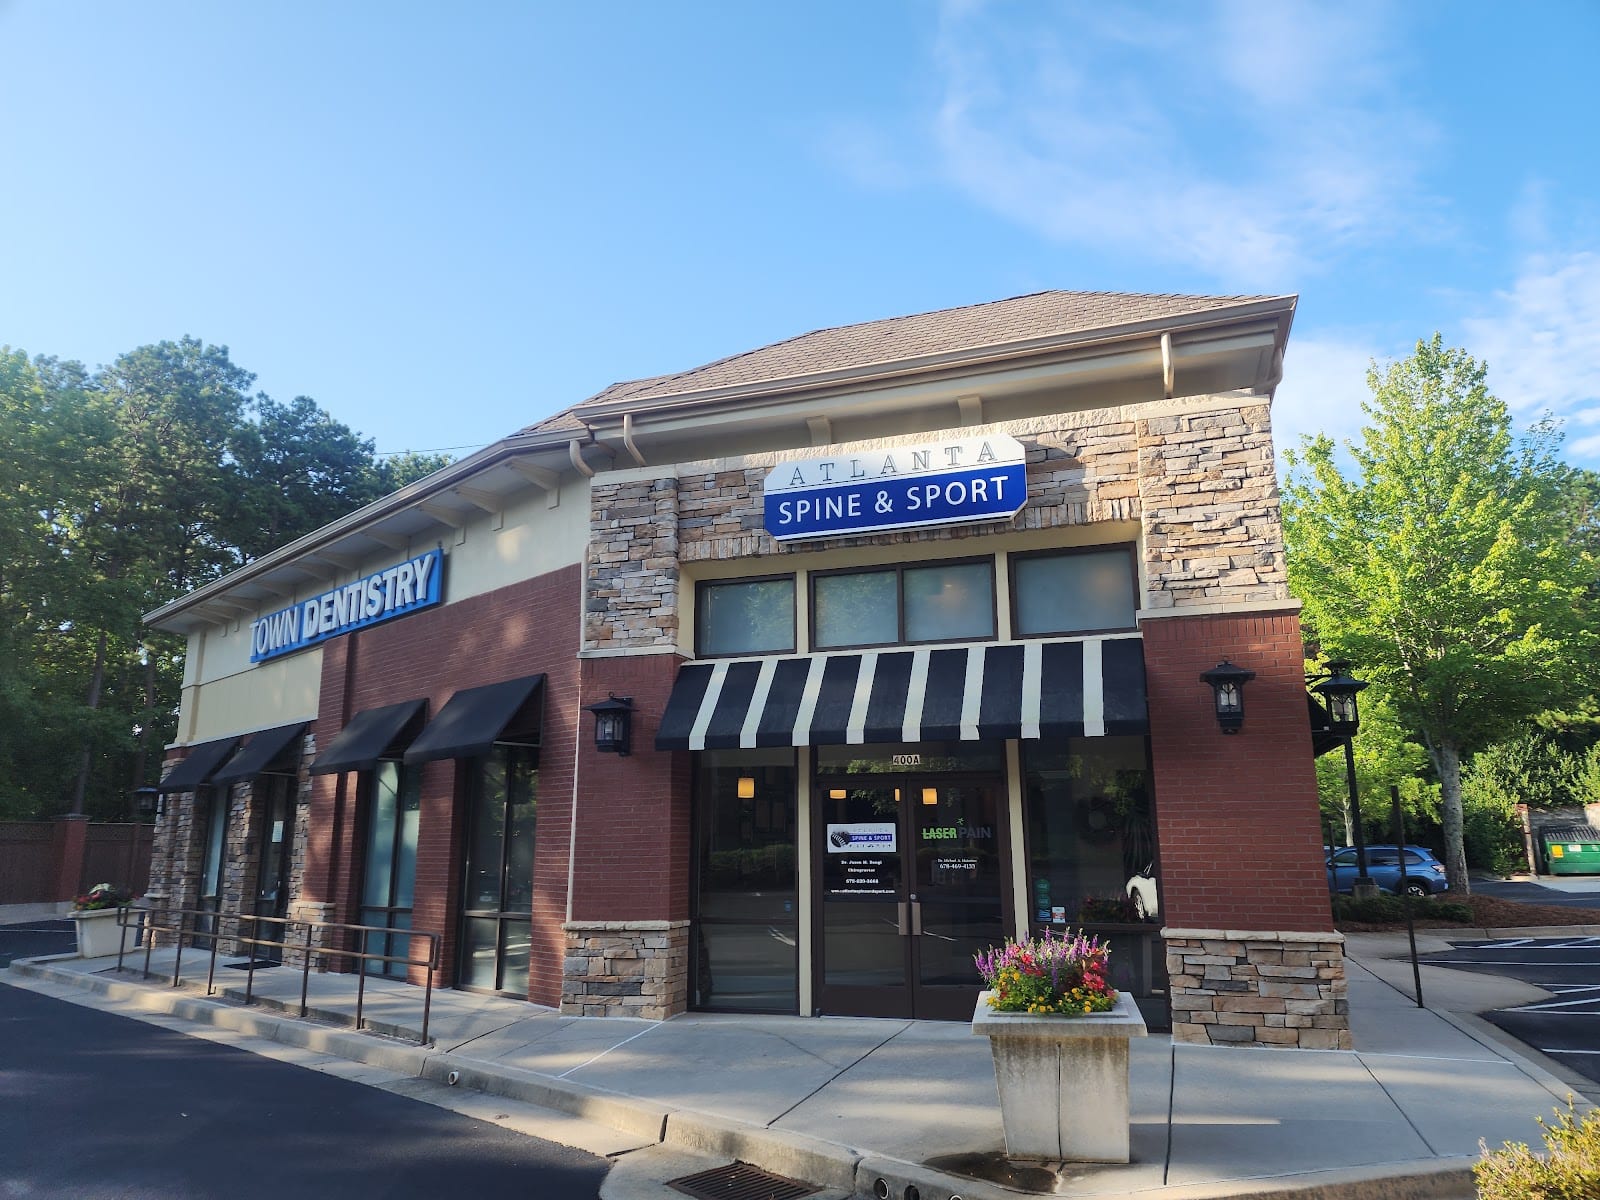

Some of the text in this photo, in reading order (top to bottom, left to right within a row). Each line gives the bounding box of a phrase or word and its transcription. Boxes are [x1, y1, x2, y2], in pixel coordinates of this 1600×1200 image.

[790, 440, 998, 485] ATLANTA
[779, 475, 1009, 524] SPINE & SPORT
[249, 554, 434, 657] TOWN DENTISTRY
[893, 755, 920, 765] 400A
[922, 826, 992, 840] LASER PAIN
